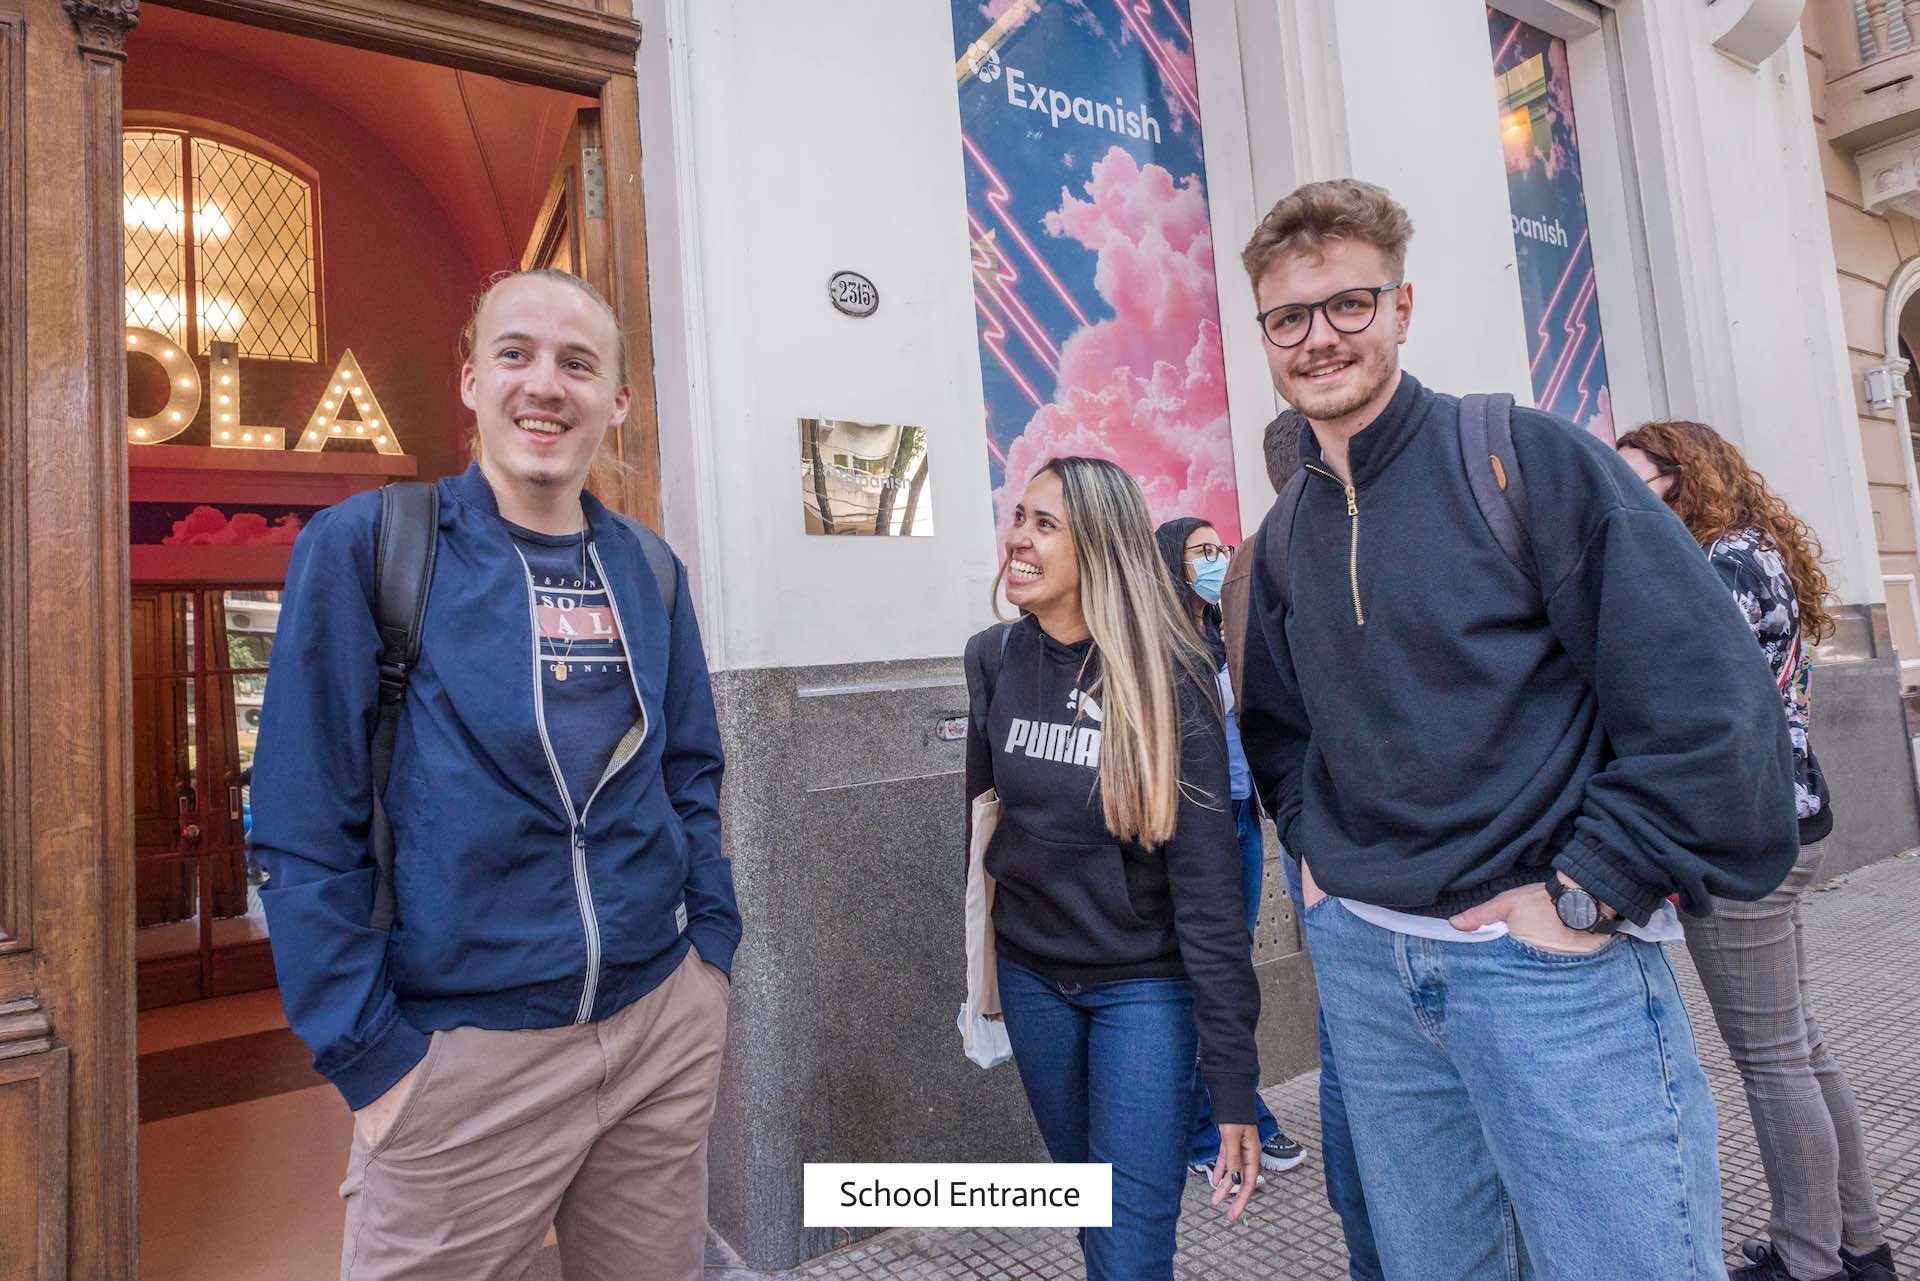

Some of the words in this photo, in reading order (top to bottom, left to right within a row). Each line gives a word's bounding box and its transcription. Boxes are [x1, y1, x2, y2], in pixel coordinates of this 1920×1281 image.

[1005, 66, 1161, 144] Expanish
[839, 280, 871, 306] 2315
[1004, 718, 1102, 768] PUMA
